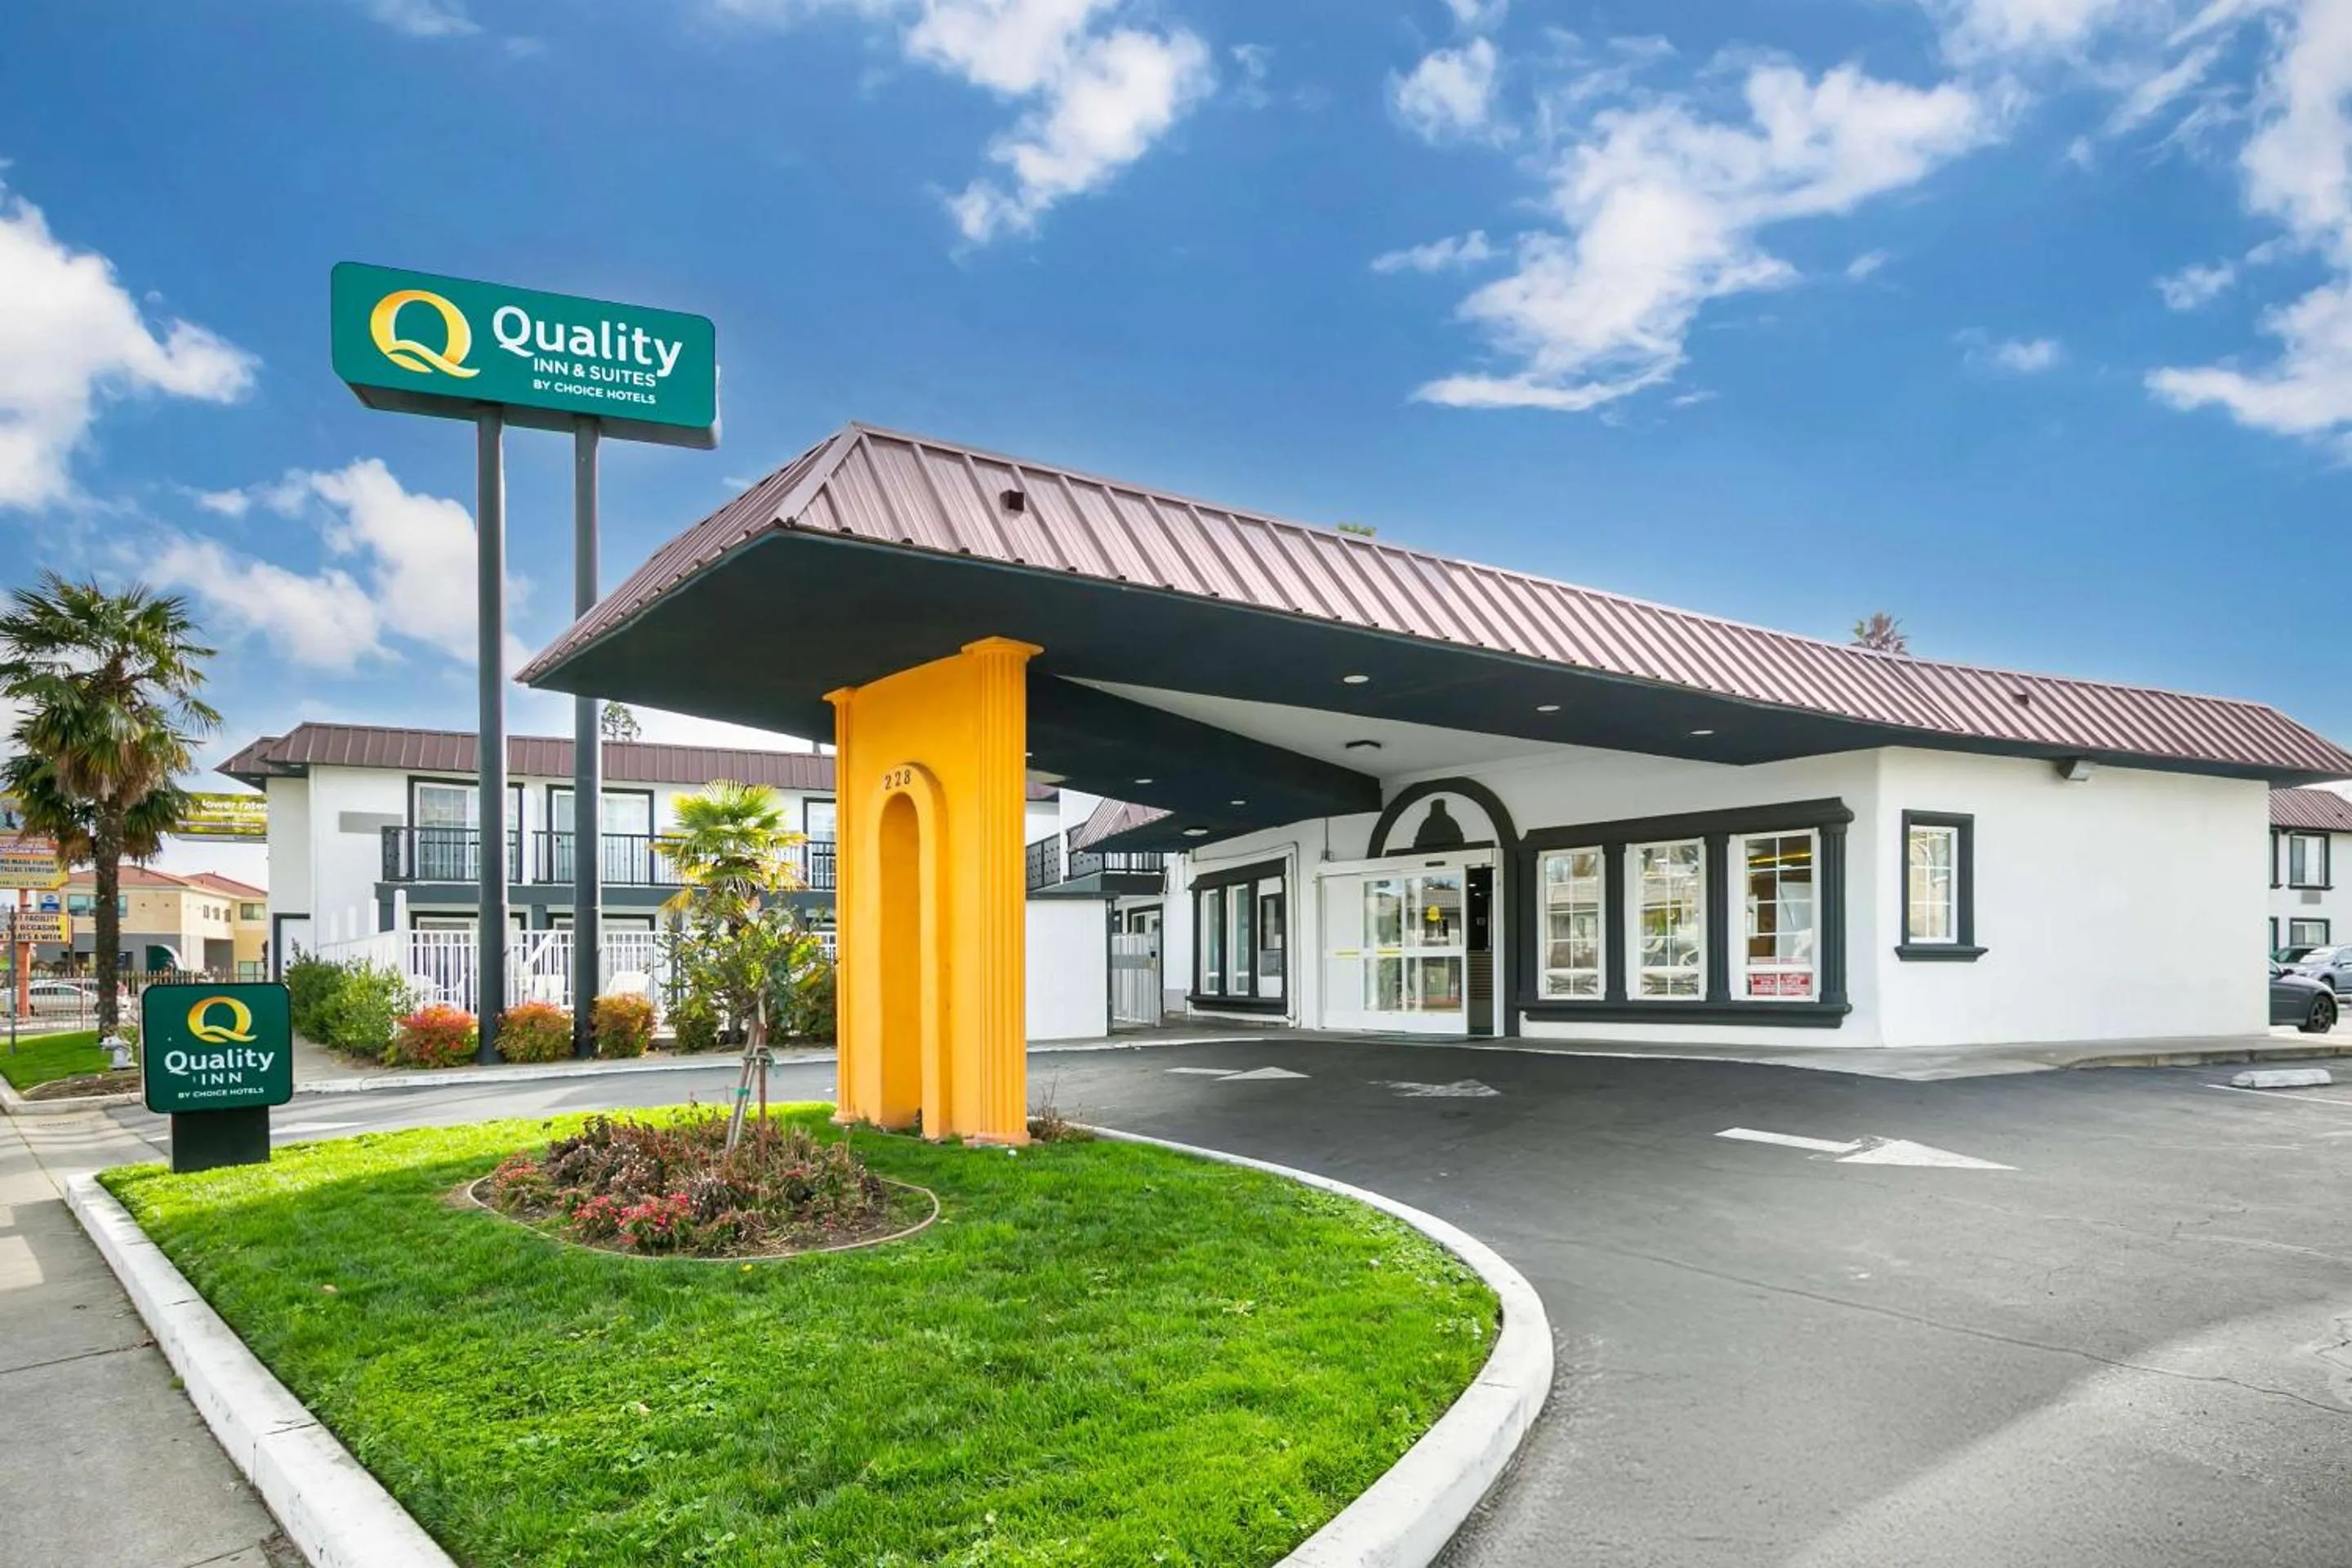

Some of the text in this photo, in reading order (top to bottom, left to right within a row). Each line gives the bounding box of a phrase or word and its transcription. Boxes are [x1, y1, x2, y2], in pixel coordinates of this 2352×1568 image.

[492, 305, 684, 377] Quality
[533, 357, 656, 387] INN & SUITES
[533, 378, 657, 404] BY CHOICE HOTELS
[885, 768, 911, 791] 228
[164, 1048, 275, 1076] Quality
[201, 1071, 243, 1085] INN
[192, 1089, 228, 1098] CHOICE
[229, 1086, 264, 1095] HOTELS
